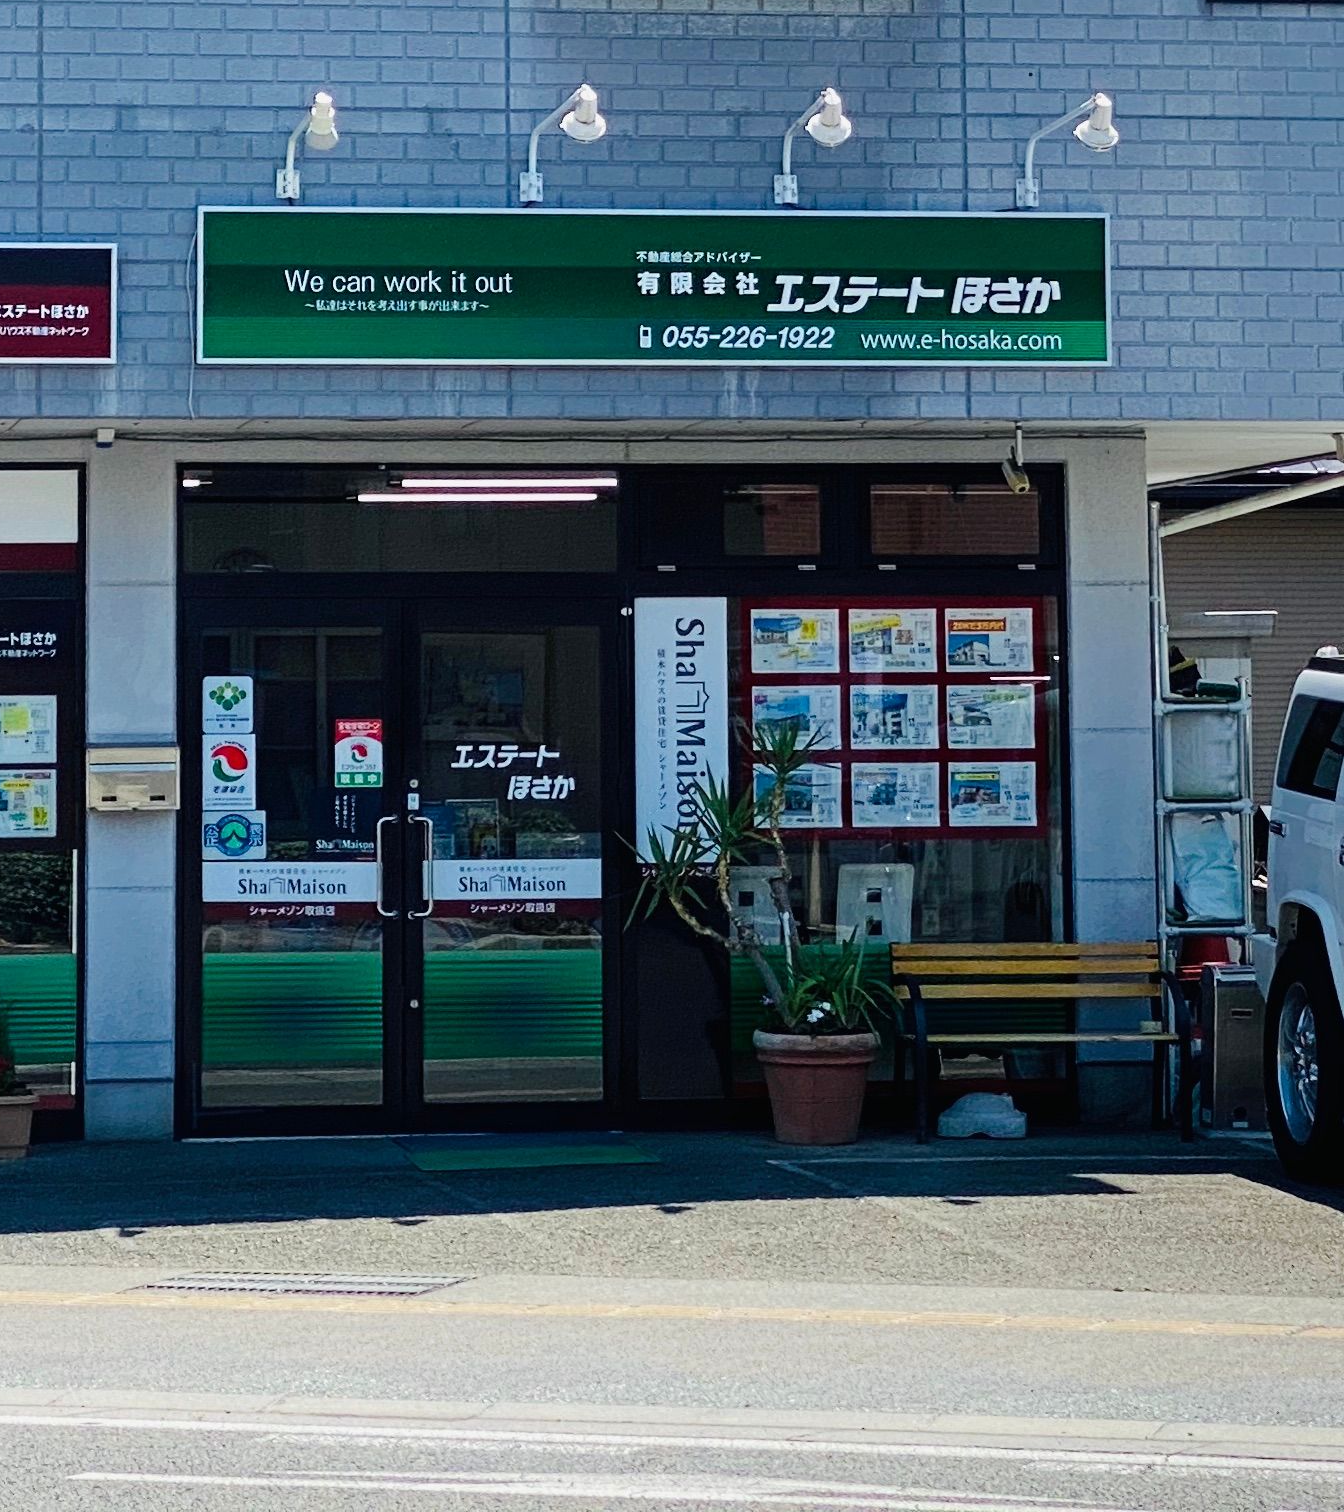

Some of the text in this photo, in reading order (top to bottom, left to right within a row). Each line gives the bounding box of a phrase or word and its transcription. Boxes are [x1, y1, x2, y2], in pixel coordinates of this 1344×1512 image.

[636, 251, 762, 264] 不動産総合アドバイザー
[284, 269, 513, 294] We can work it out
[637, 271, 760, 295] 有限会社
[662, 325, 1063, 351] 055-226-1922 www.e-hosaka.com
[451, 745, 560, 768] エステート
[507, 775, 576, 800] ほさか
